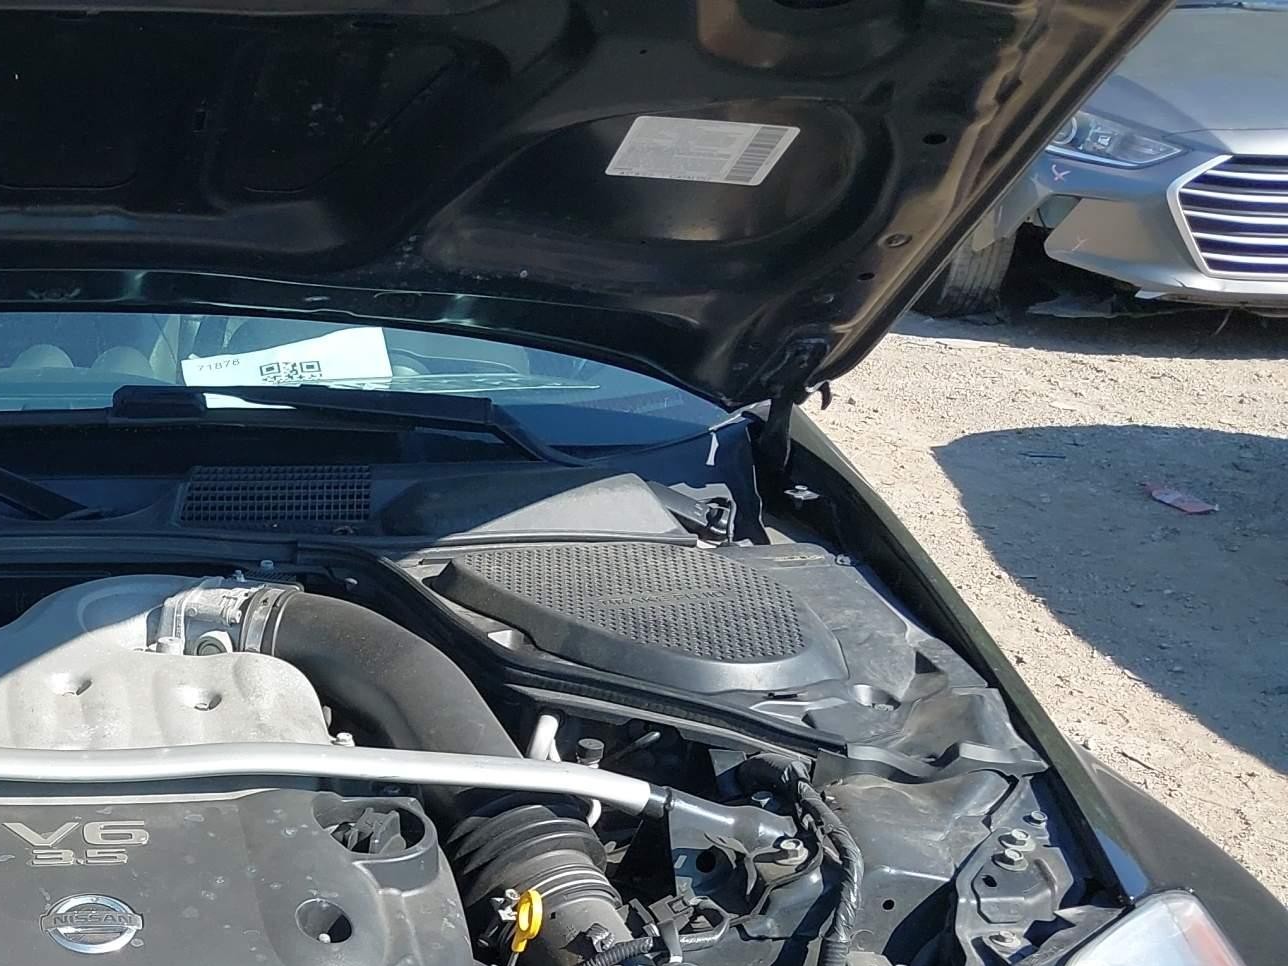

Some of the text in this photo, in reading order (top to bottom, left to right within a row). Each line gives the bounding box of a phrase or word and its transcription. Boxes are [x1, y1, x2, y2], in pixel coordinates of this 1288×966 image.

[1, 820, 150, 846] V6
[30, 848, 128, 866] 3.5
[53, 913, 133, 925] NISSAN
